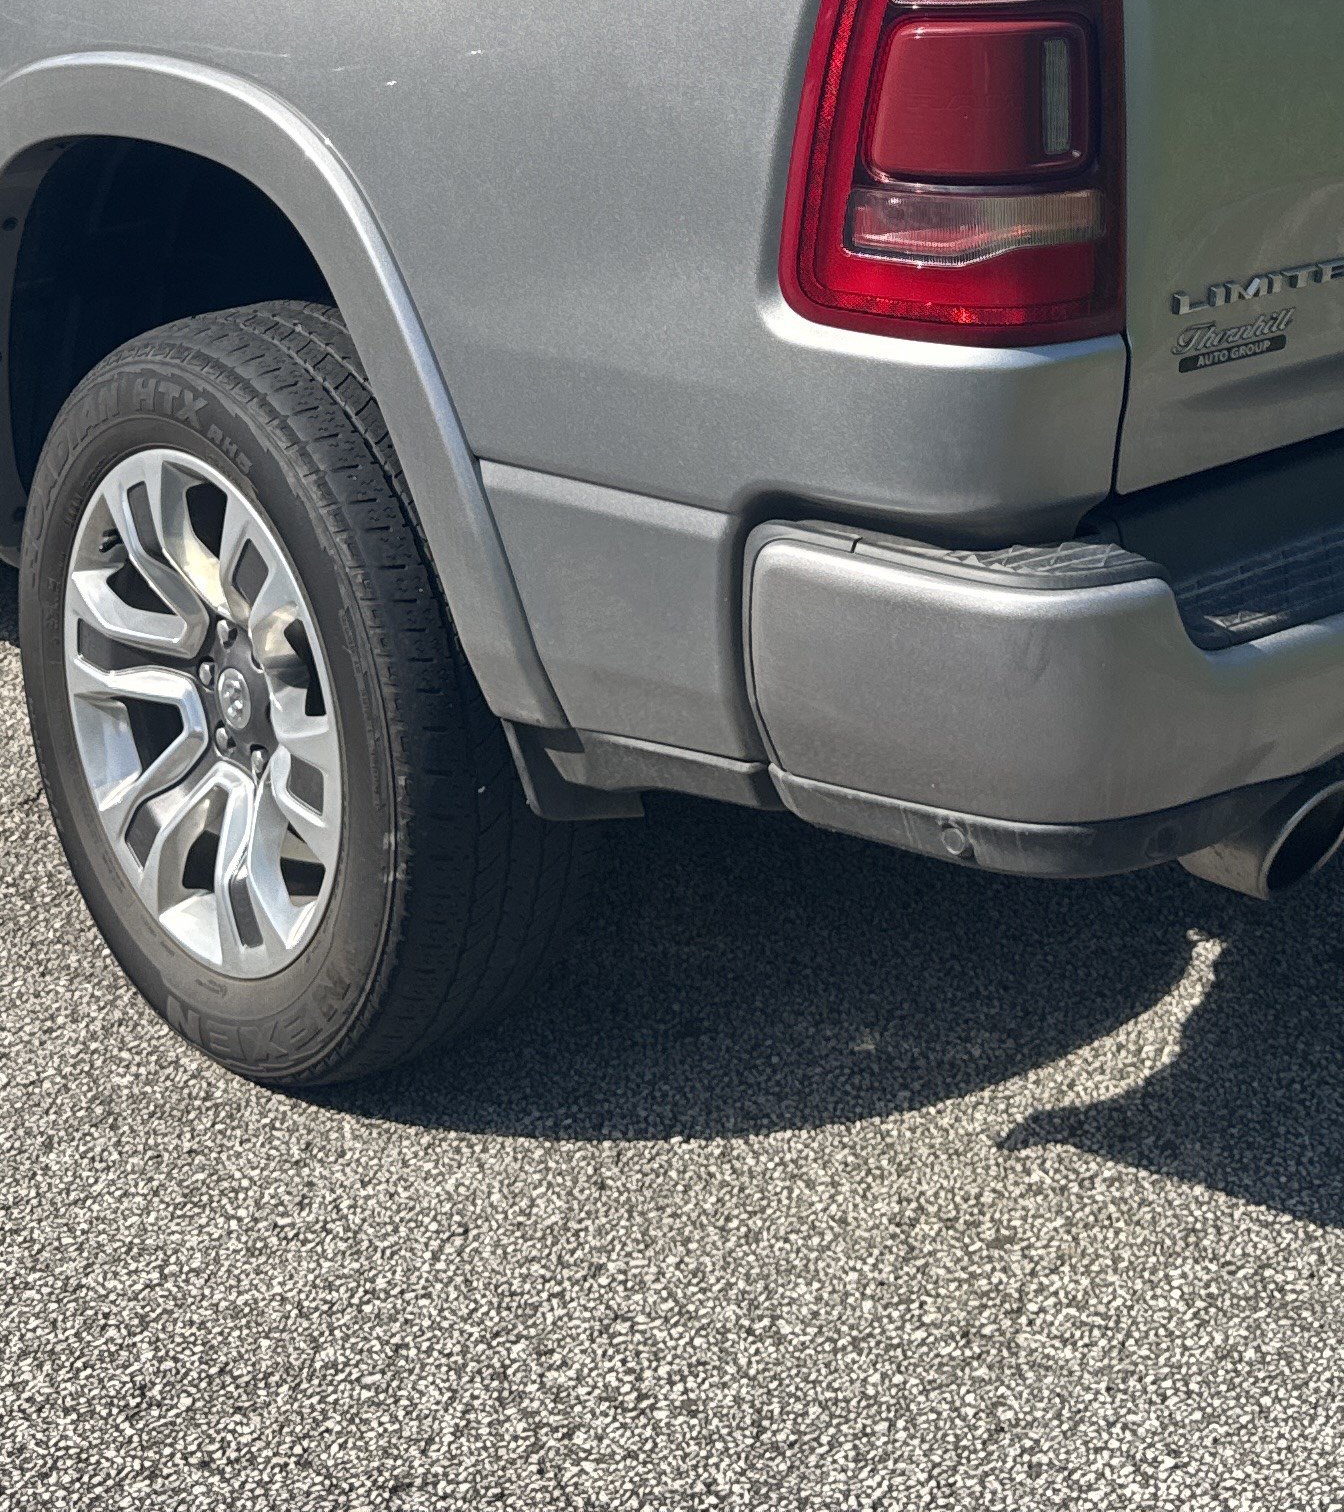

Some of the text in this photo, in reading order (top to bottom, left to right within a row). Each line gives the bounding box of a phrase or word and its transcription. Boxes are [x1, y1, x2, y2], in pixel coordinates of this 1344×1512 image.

[1171, 306, 1296, 355] Thornhill
[1197, 339, 1272, 367] AUTO GROUP
[132, 376, 208, 429] HTX
[166, 961, 353, 1065] NEXEN
